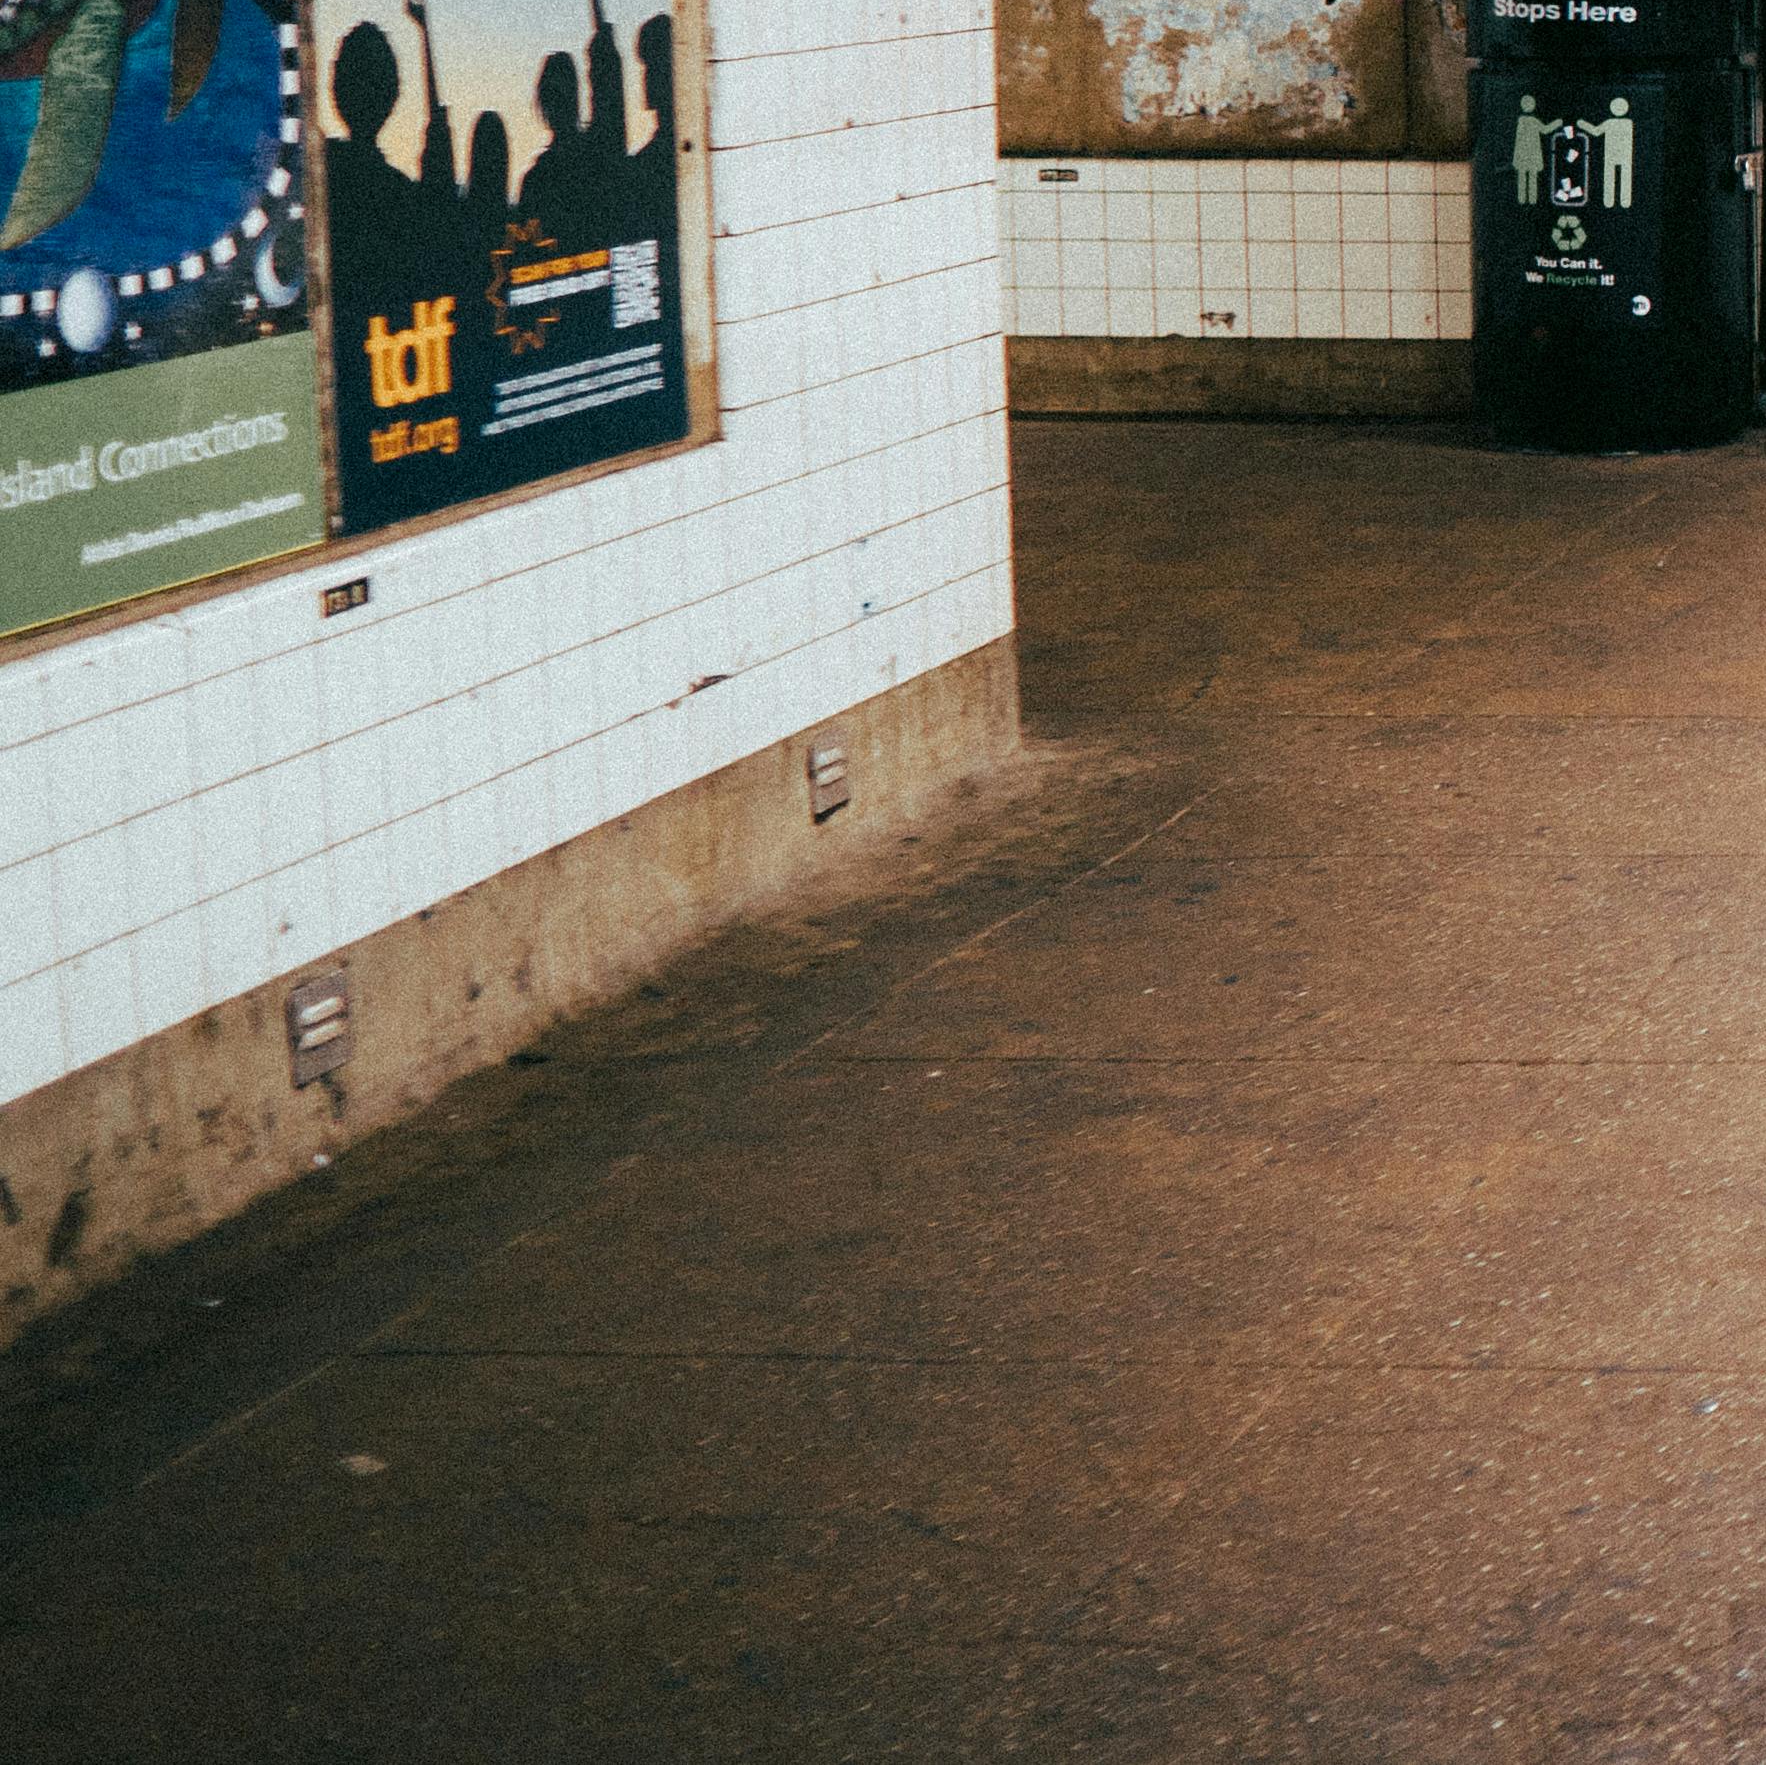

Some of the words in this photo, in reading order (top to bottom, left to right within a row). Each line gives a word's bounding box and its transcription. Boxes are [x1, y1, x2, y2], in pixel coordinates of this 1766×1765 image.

[1568, 0, 1637, 23] Here
[1535, 255, 1557, 269] You
[1560, 256, 1586, 270] Can
[1525, 271, 1544, 284] We
[1546, 272, 1597, 287] Recycle
[364, 295, 456, 408] tdf
[0, 444, 96, 510] sland
[100, 411, 289, 482] Connections
